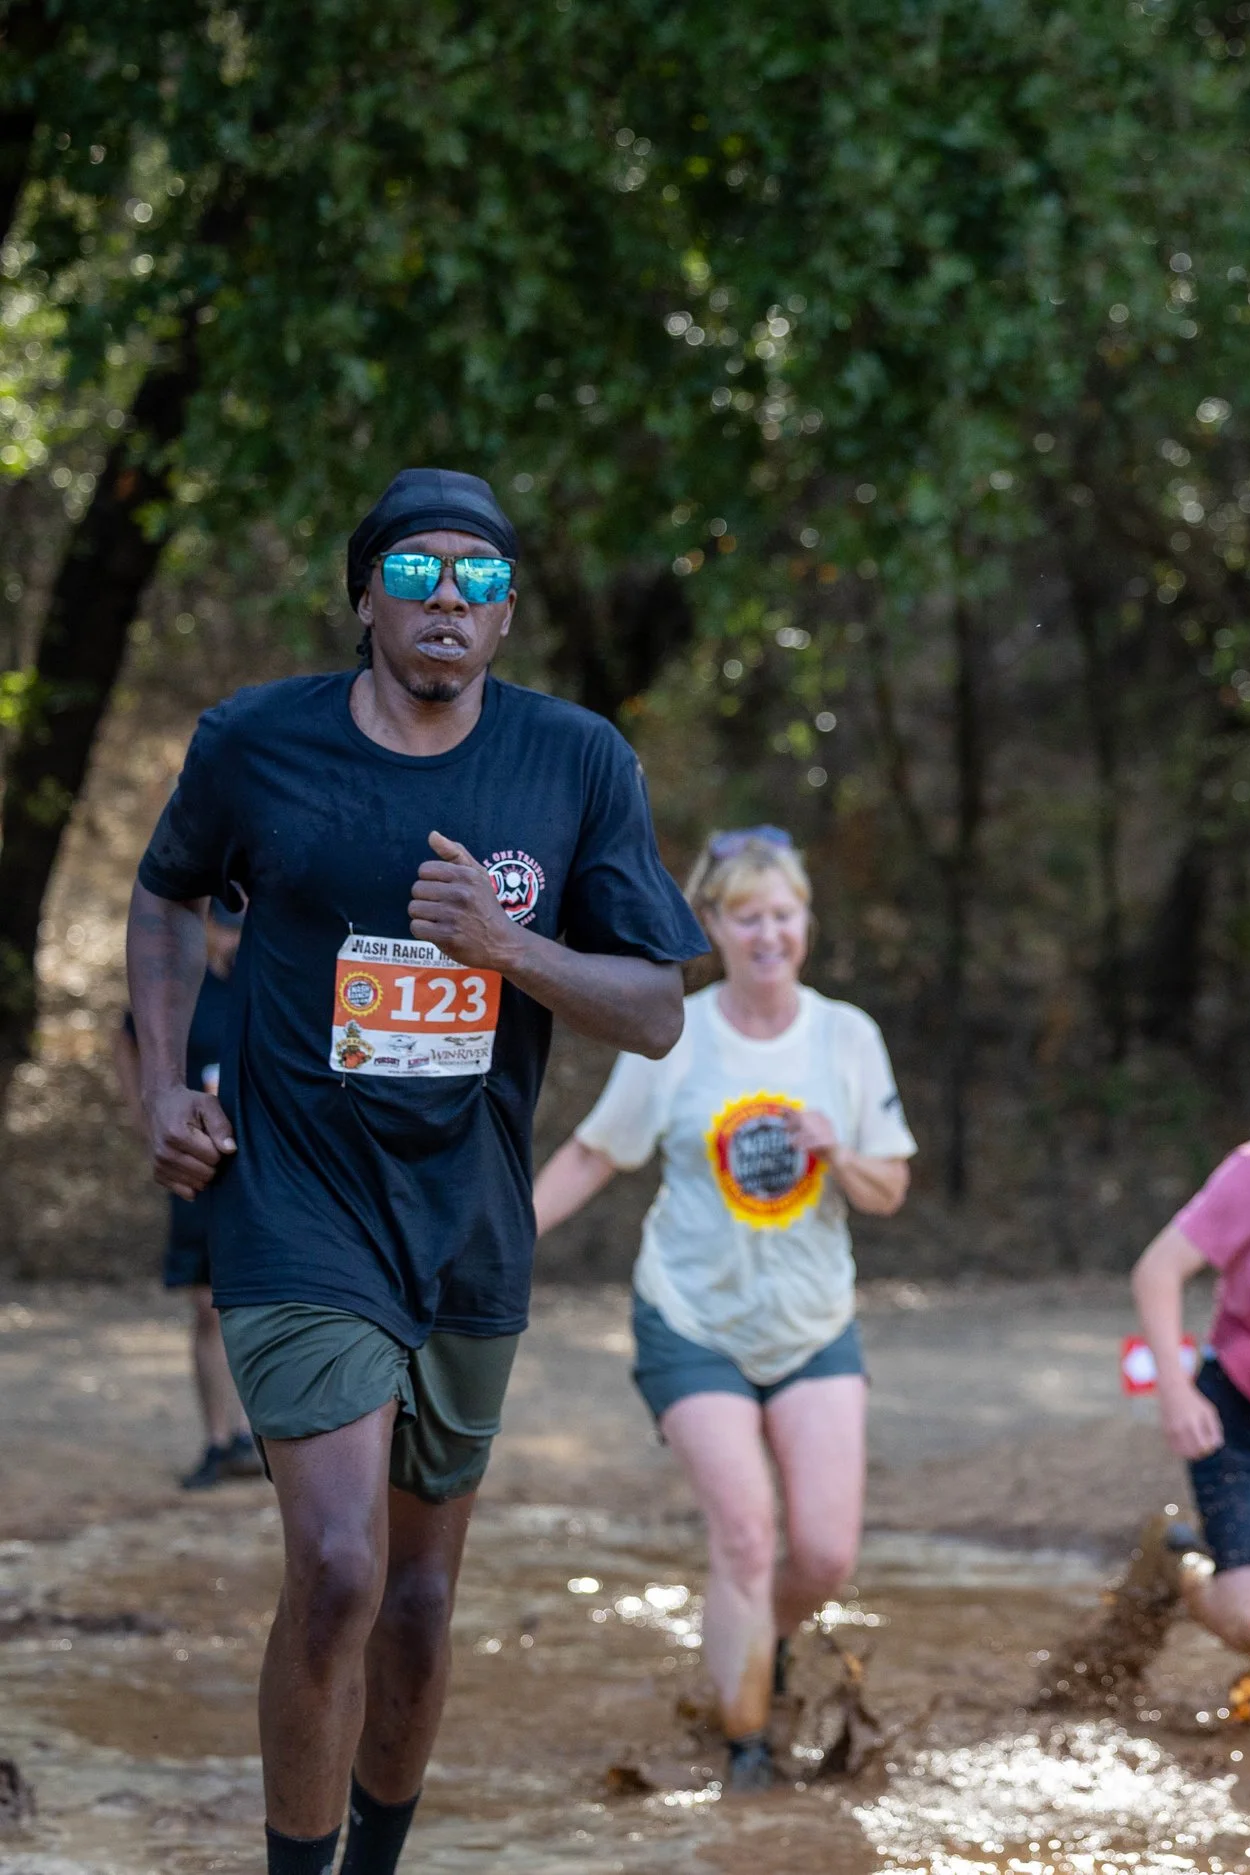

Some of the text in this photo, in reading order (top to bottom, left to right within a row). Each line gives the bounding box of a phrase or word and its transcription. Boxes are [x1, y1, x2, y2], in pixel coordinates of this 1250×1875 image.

[492, 850, 514, 861] ONE
[354, 939, 388, 955] NASH
[392, 943, 435, 960] RANCH
[390, 975, 488, 1022] 123
